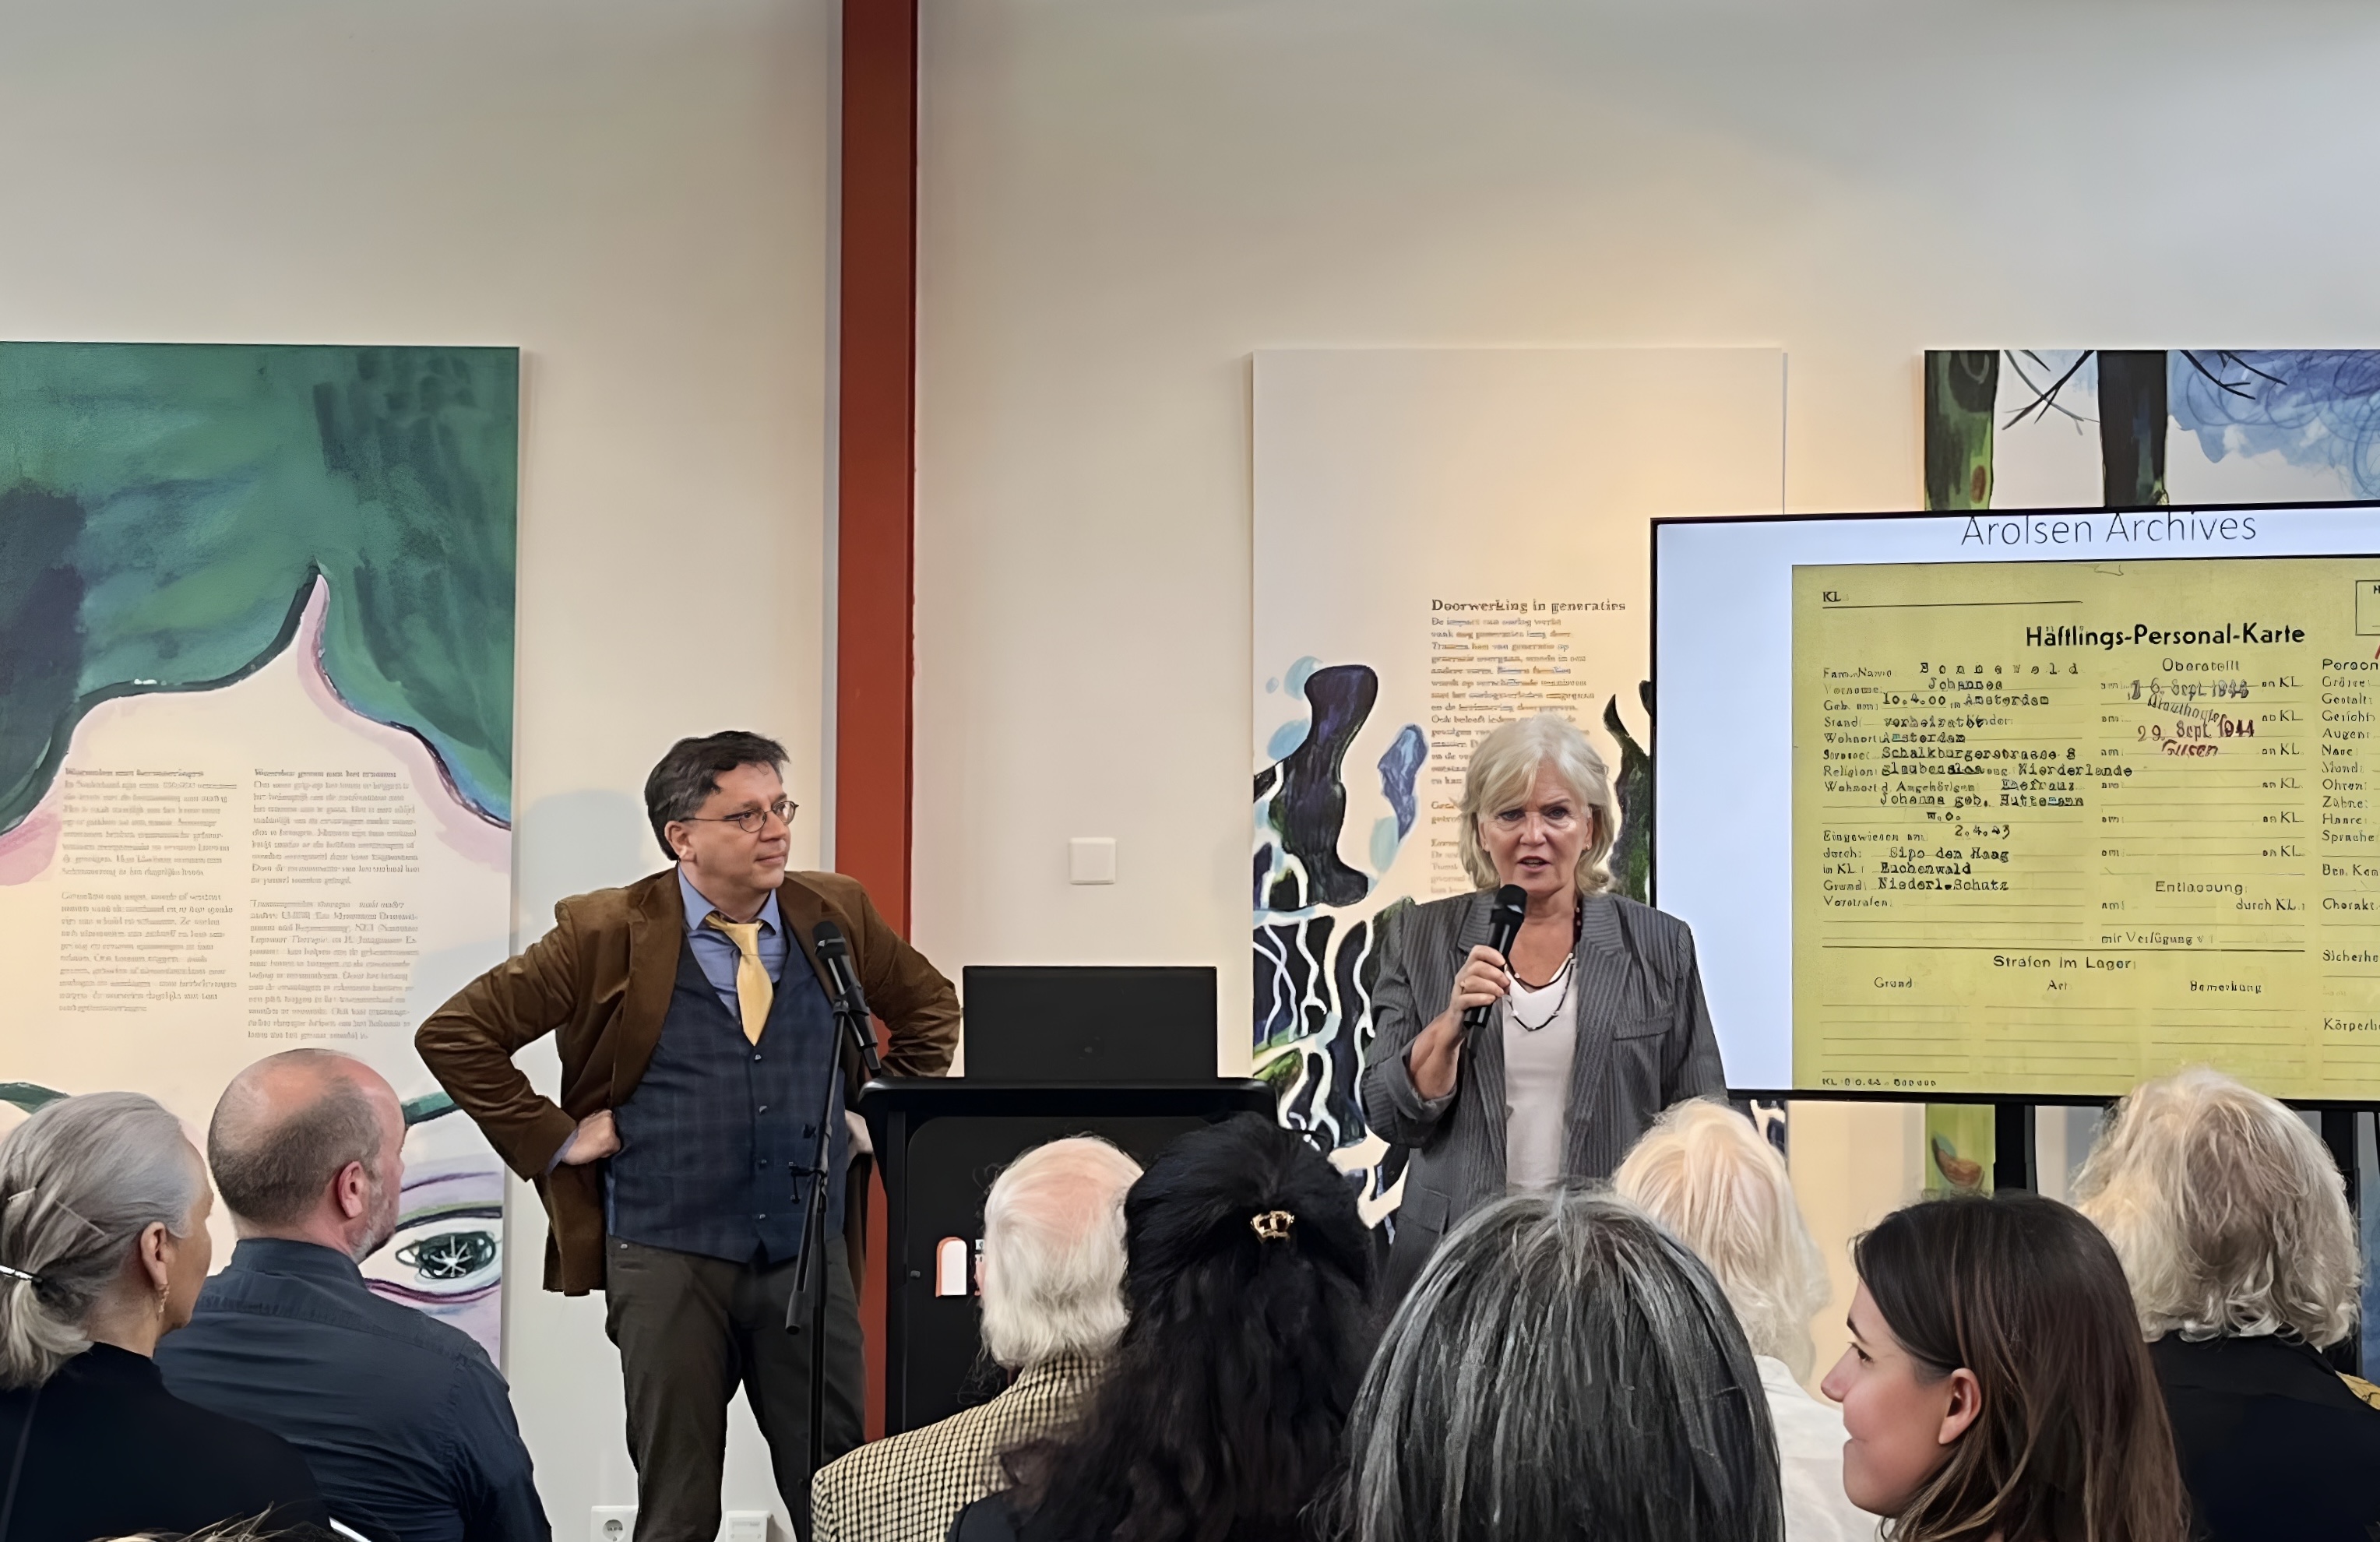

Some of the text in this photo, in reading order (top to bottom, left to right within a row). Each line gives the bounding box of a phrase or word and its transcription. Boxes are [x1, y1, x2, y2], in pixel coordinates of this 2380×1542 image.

[1961, 511, 2258, 545] Arolsen Archives
[1431, 598, 1626, 614] Doorwerking in generaties
[2025, 621, 2306, 650] Häftlings-Personal-Karte
